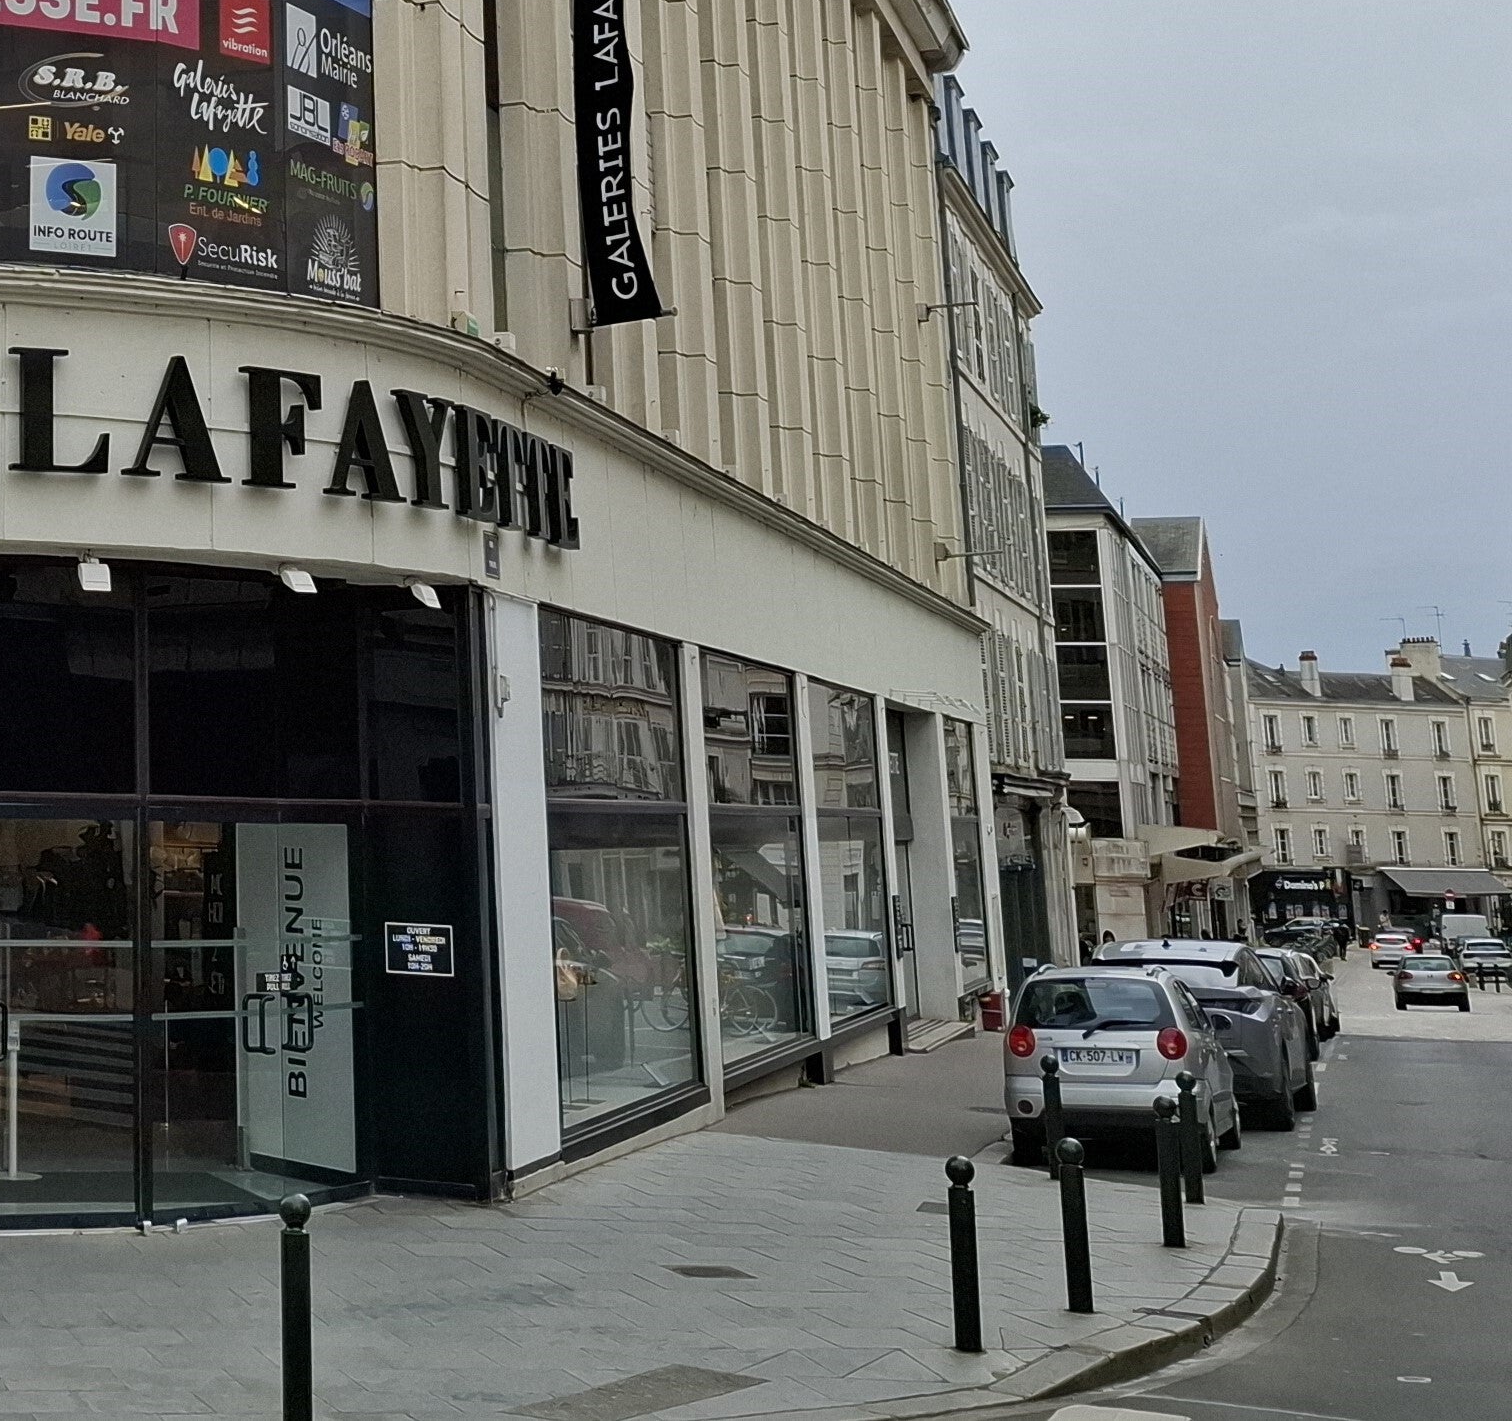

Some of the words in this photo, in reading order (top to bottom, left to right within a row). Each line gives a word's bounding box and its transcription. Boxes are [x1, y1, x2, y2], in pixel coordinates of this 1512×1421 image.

[222, 37, 268, 58] vibration
[320, 28, 372, 74] Orléans
[33, 65, 123, 91] S.R.B.
[321, 53, 358, 88] Mairie
[53, 89, 130, 105] BLANCHARD
[290, 92, 329, 134] JBL
[64, 122, 105, 143] Yale
[184, 184, 194, 199] P.
[290, 159, 357, 200] MAG-FRUITS
[212, 208, 224, 220] de
[227, 210, 262, 227] Jardins
[596, 107, 638, 300] GALERIES
[34, 225, 64, 238] INFO
[68, 228, 113, 243] ROUTE
[198, 236, 278, 269] SecuRisk
[8, 347, 580, 550] LAFAYETTE
